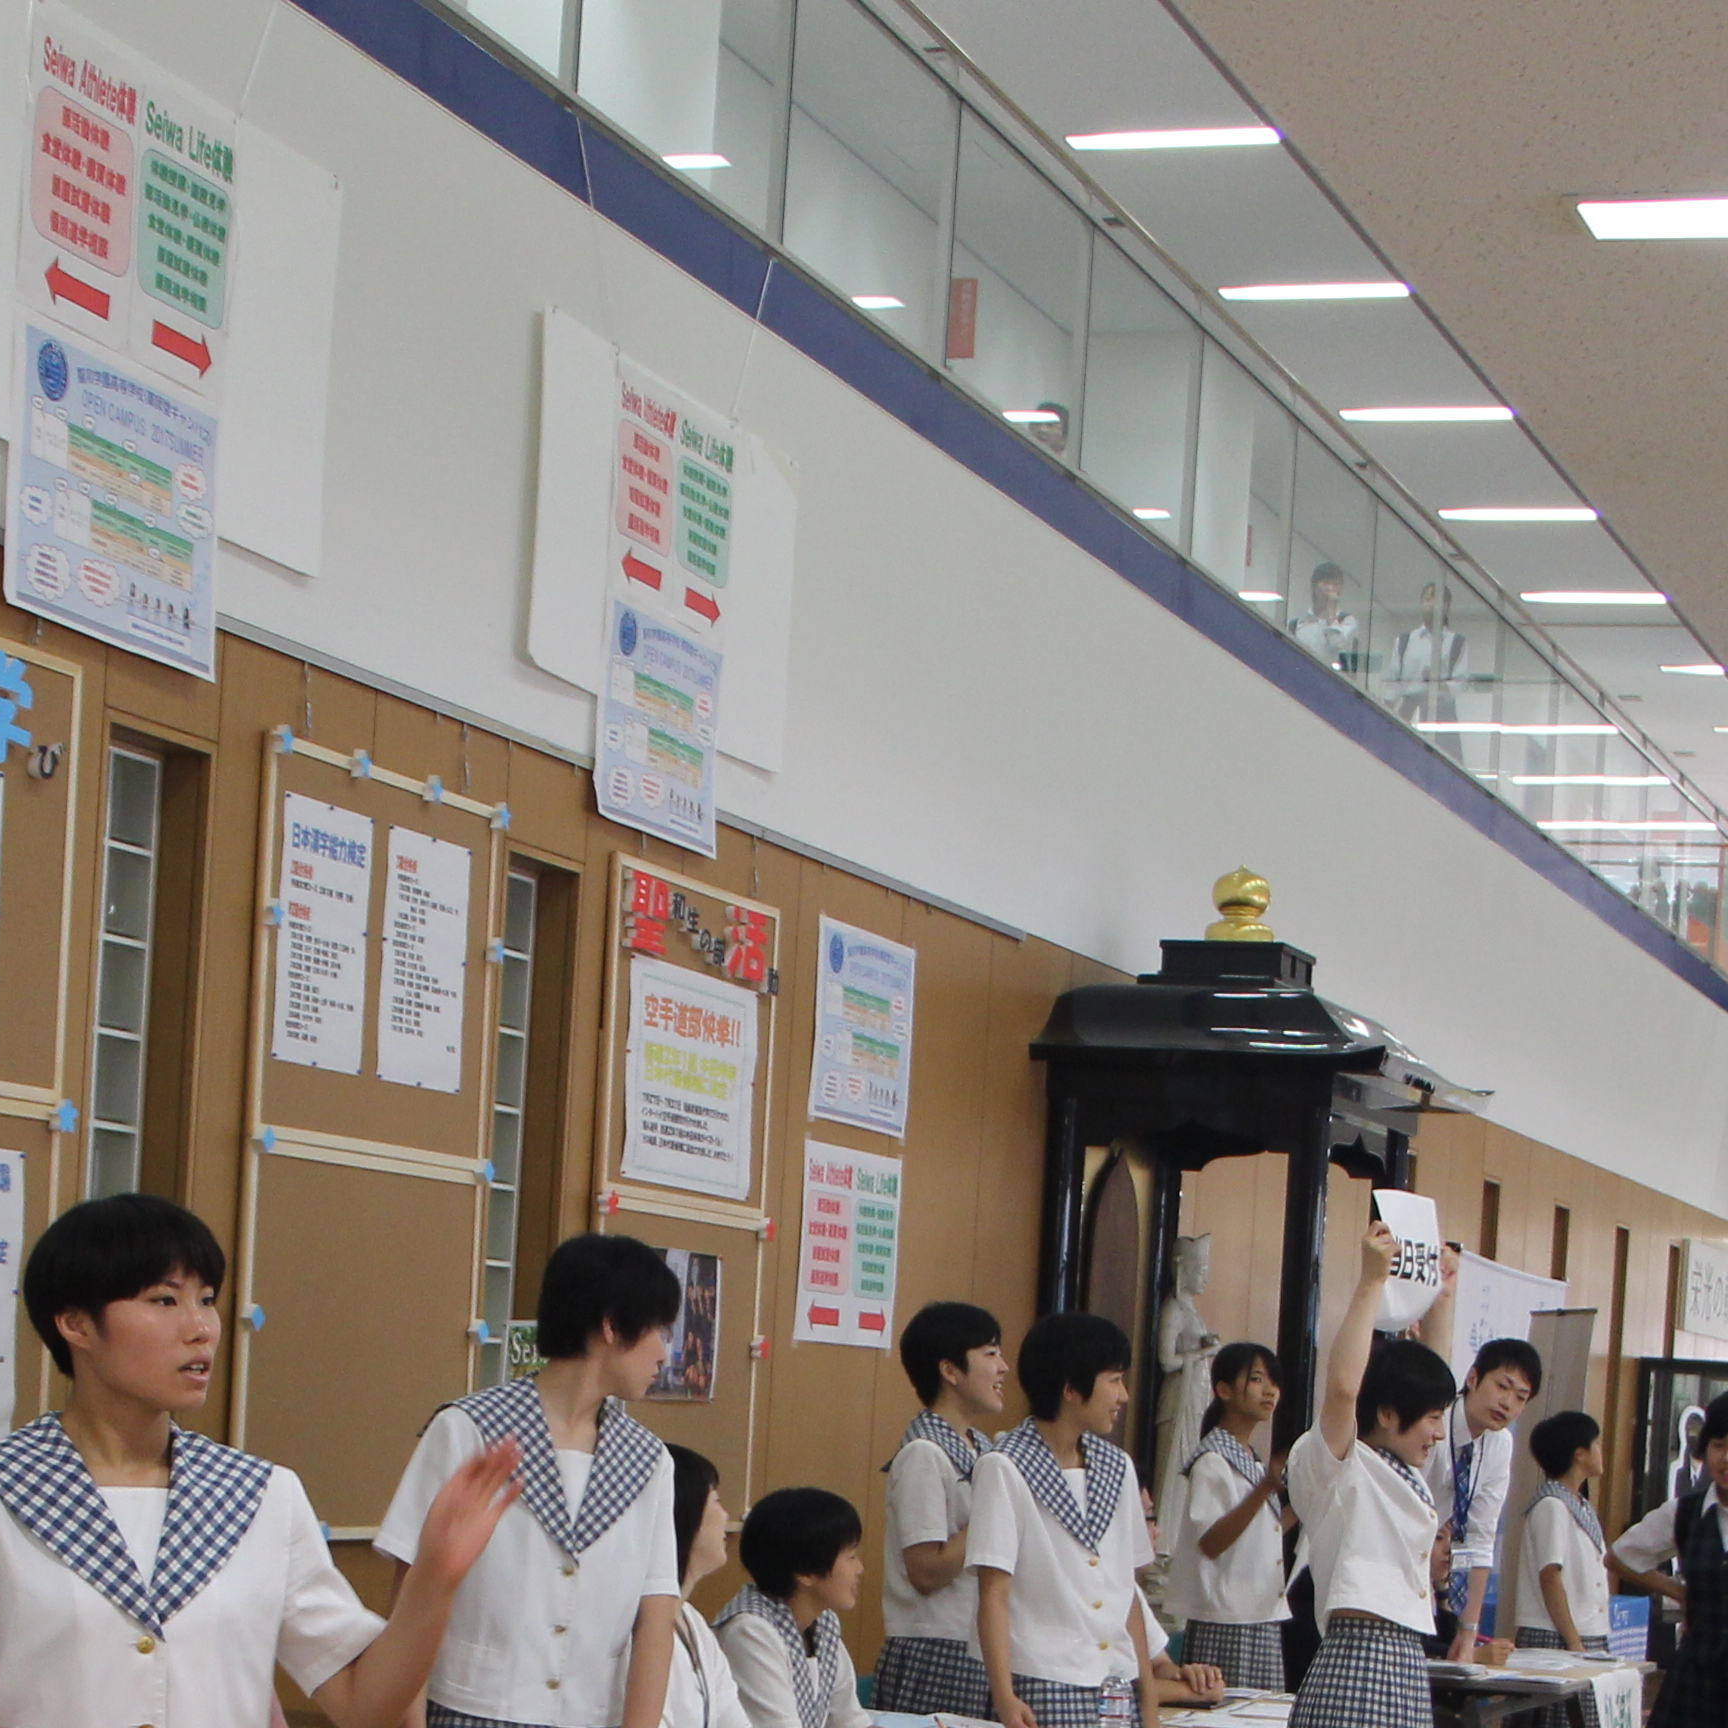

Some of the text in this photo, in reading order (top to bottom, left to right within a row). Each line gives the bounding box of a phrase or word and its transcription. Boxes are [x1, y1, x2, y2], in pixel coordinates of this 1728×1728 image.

[43, 36, 75, 88] Seiwa
[145, 100, 183, 153] Seiwa
[291, 822, 367, 869] 日本漢字能力検定
